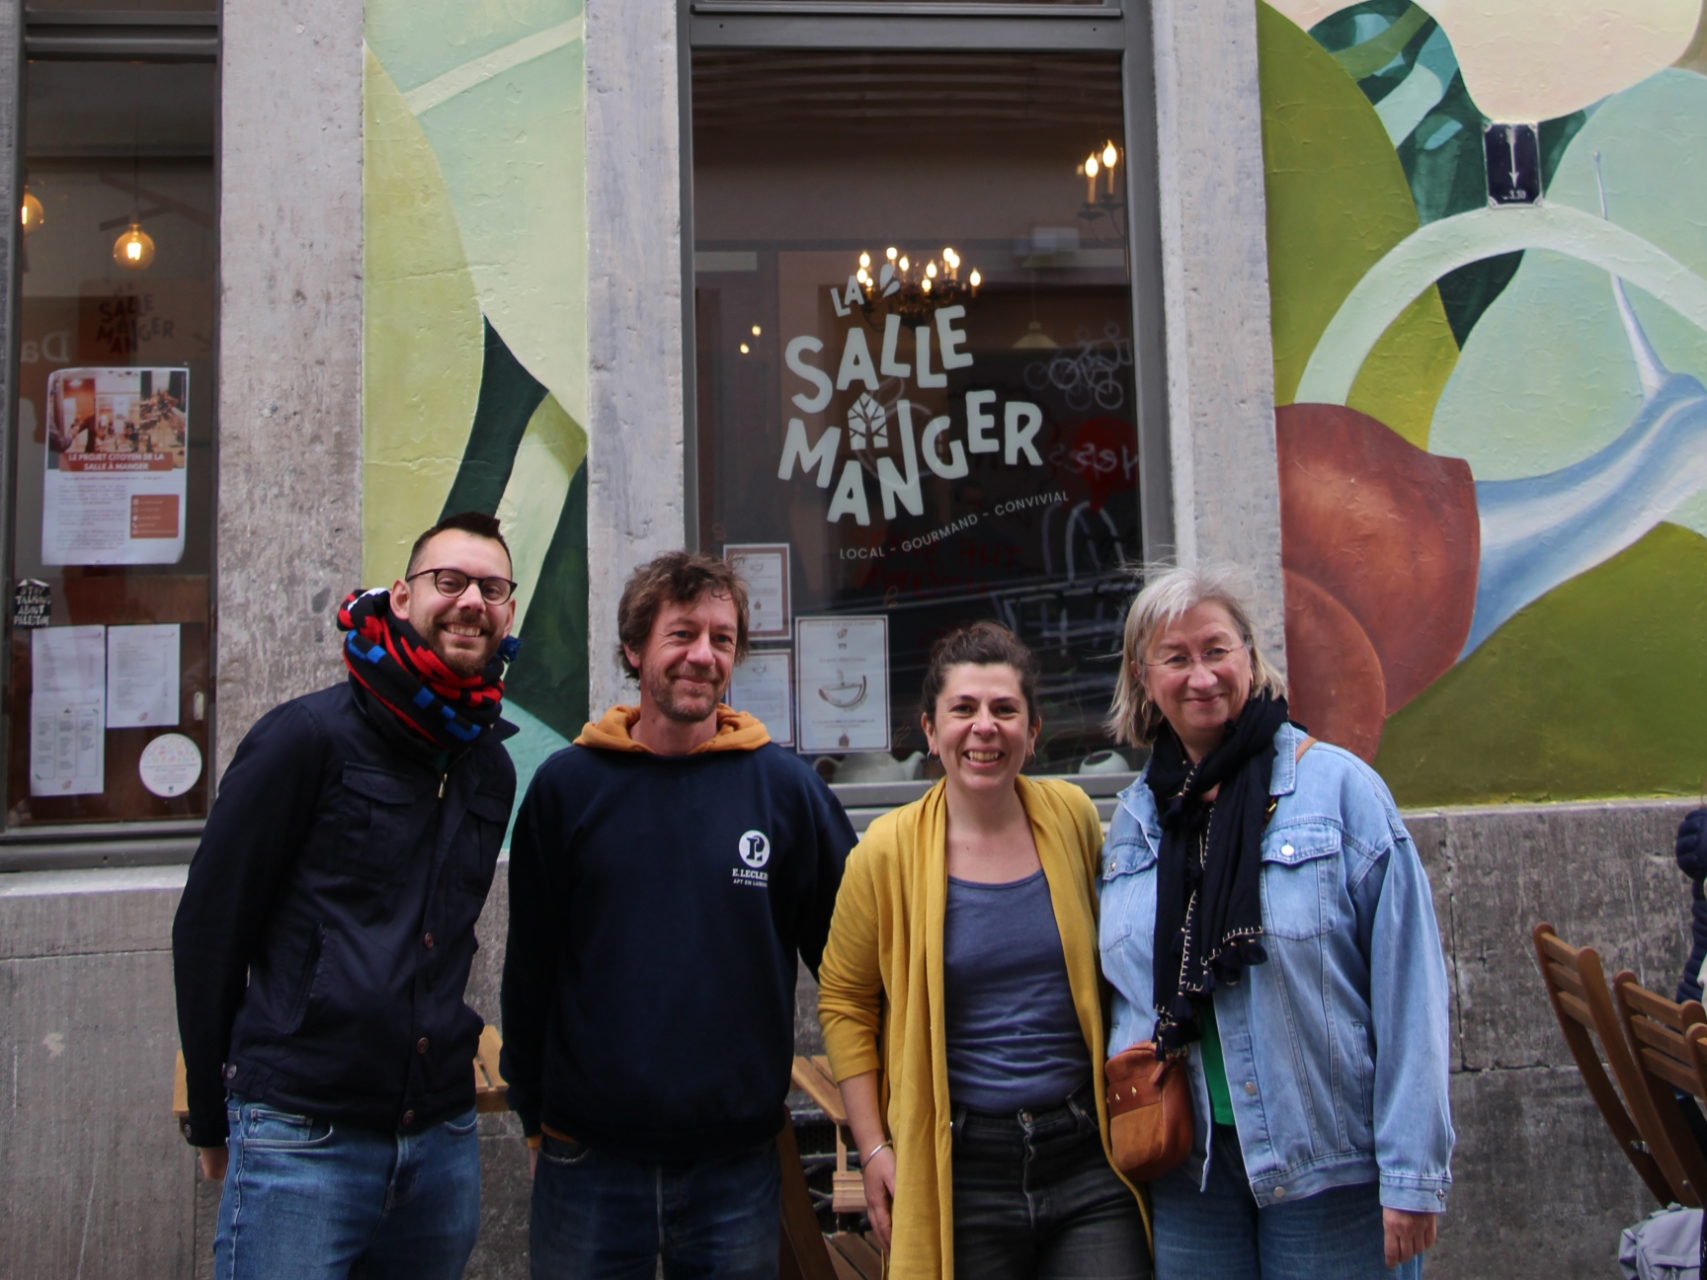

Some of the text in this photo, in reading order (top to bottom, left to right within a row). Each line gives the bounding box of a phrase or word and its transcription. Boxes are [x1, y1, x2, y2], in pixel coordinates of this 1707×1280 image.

[830, 275, 865, 318] LA
[785, 305, 973, 414] SALLE
[78, 453, 107, 462] PROJET
[154, 453, 164, 461] LA
[84, 463, 106, 471] SALLE
[115, 463, 149, 471] MANGER
[777, 390, 1043, 526] MANGER
[839, 546, 885, 560] LOCAL
[901, 513, 978, 552] GOURMAND
[994, 490, 1069, 517] CONVIVIAL
